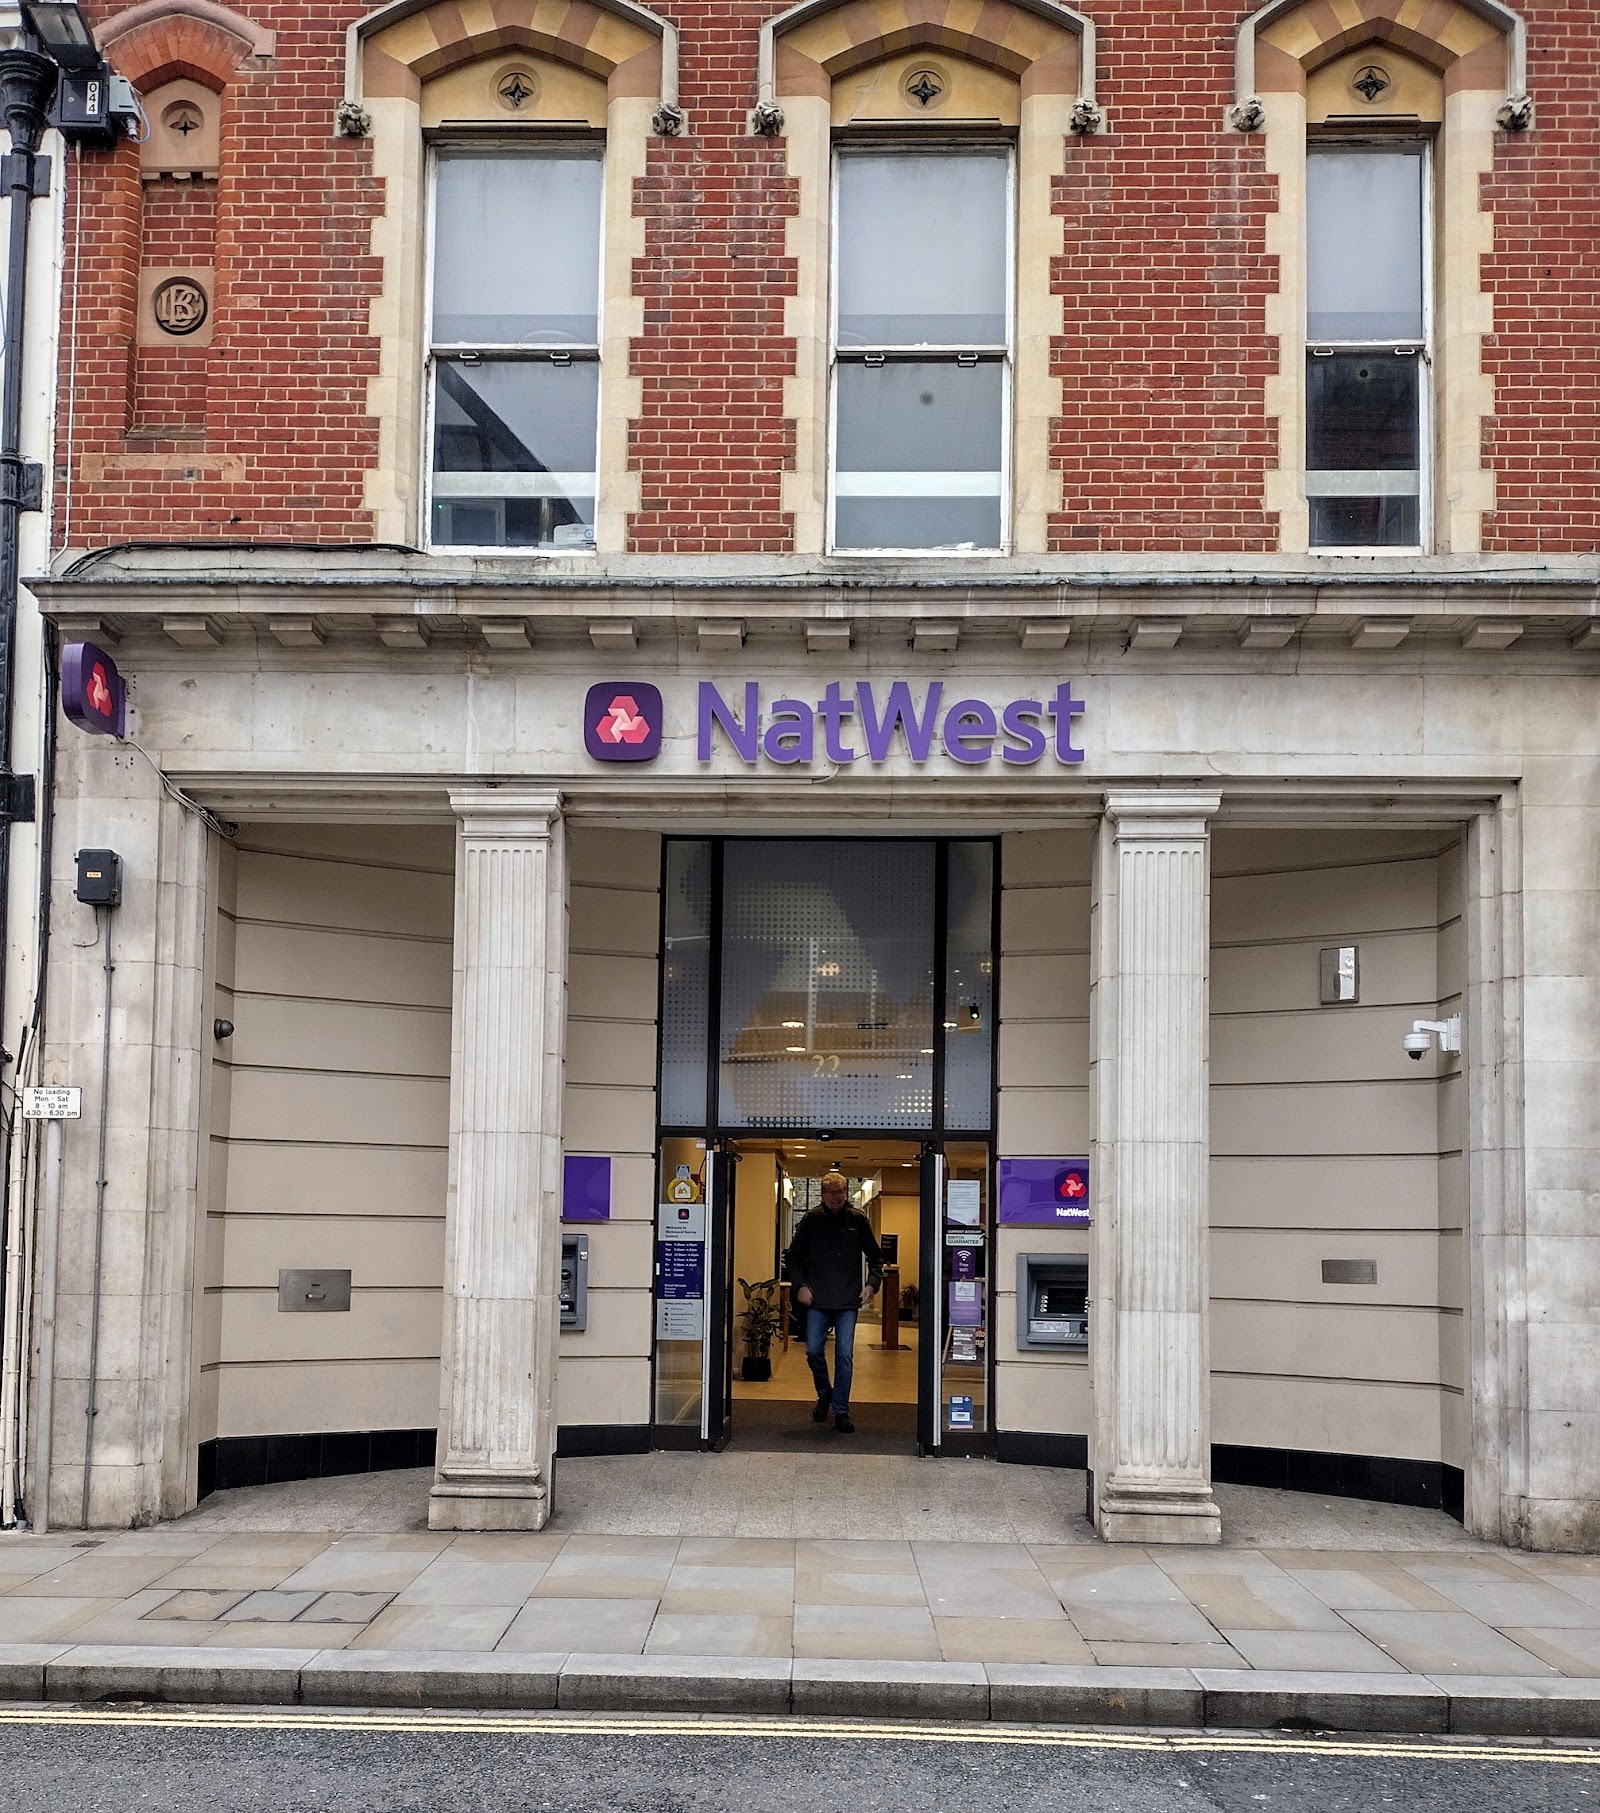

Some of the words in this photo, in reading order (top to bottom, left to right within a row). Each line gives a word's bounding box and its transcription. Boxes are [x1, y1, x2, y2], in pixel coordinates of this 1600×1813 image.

[89, 83, 97, 113] 044
[697, 680, 1086, 766] NatWest
[1056, 1208, 1089, 1216] NatWest
